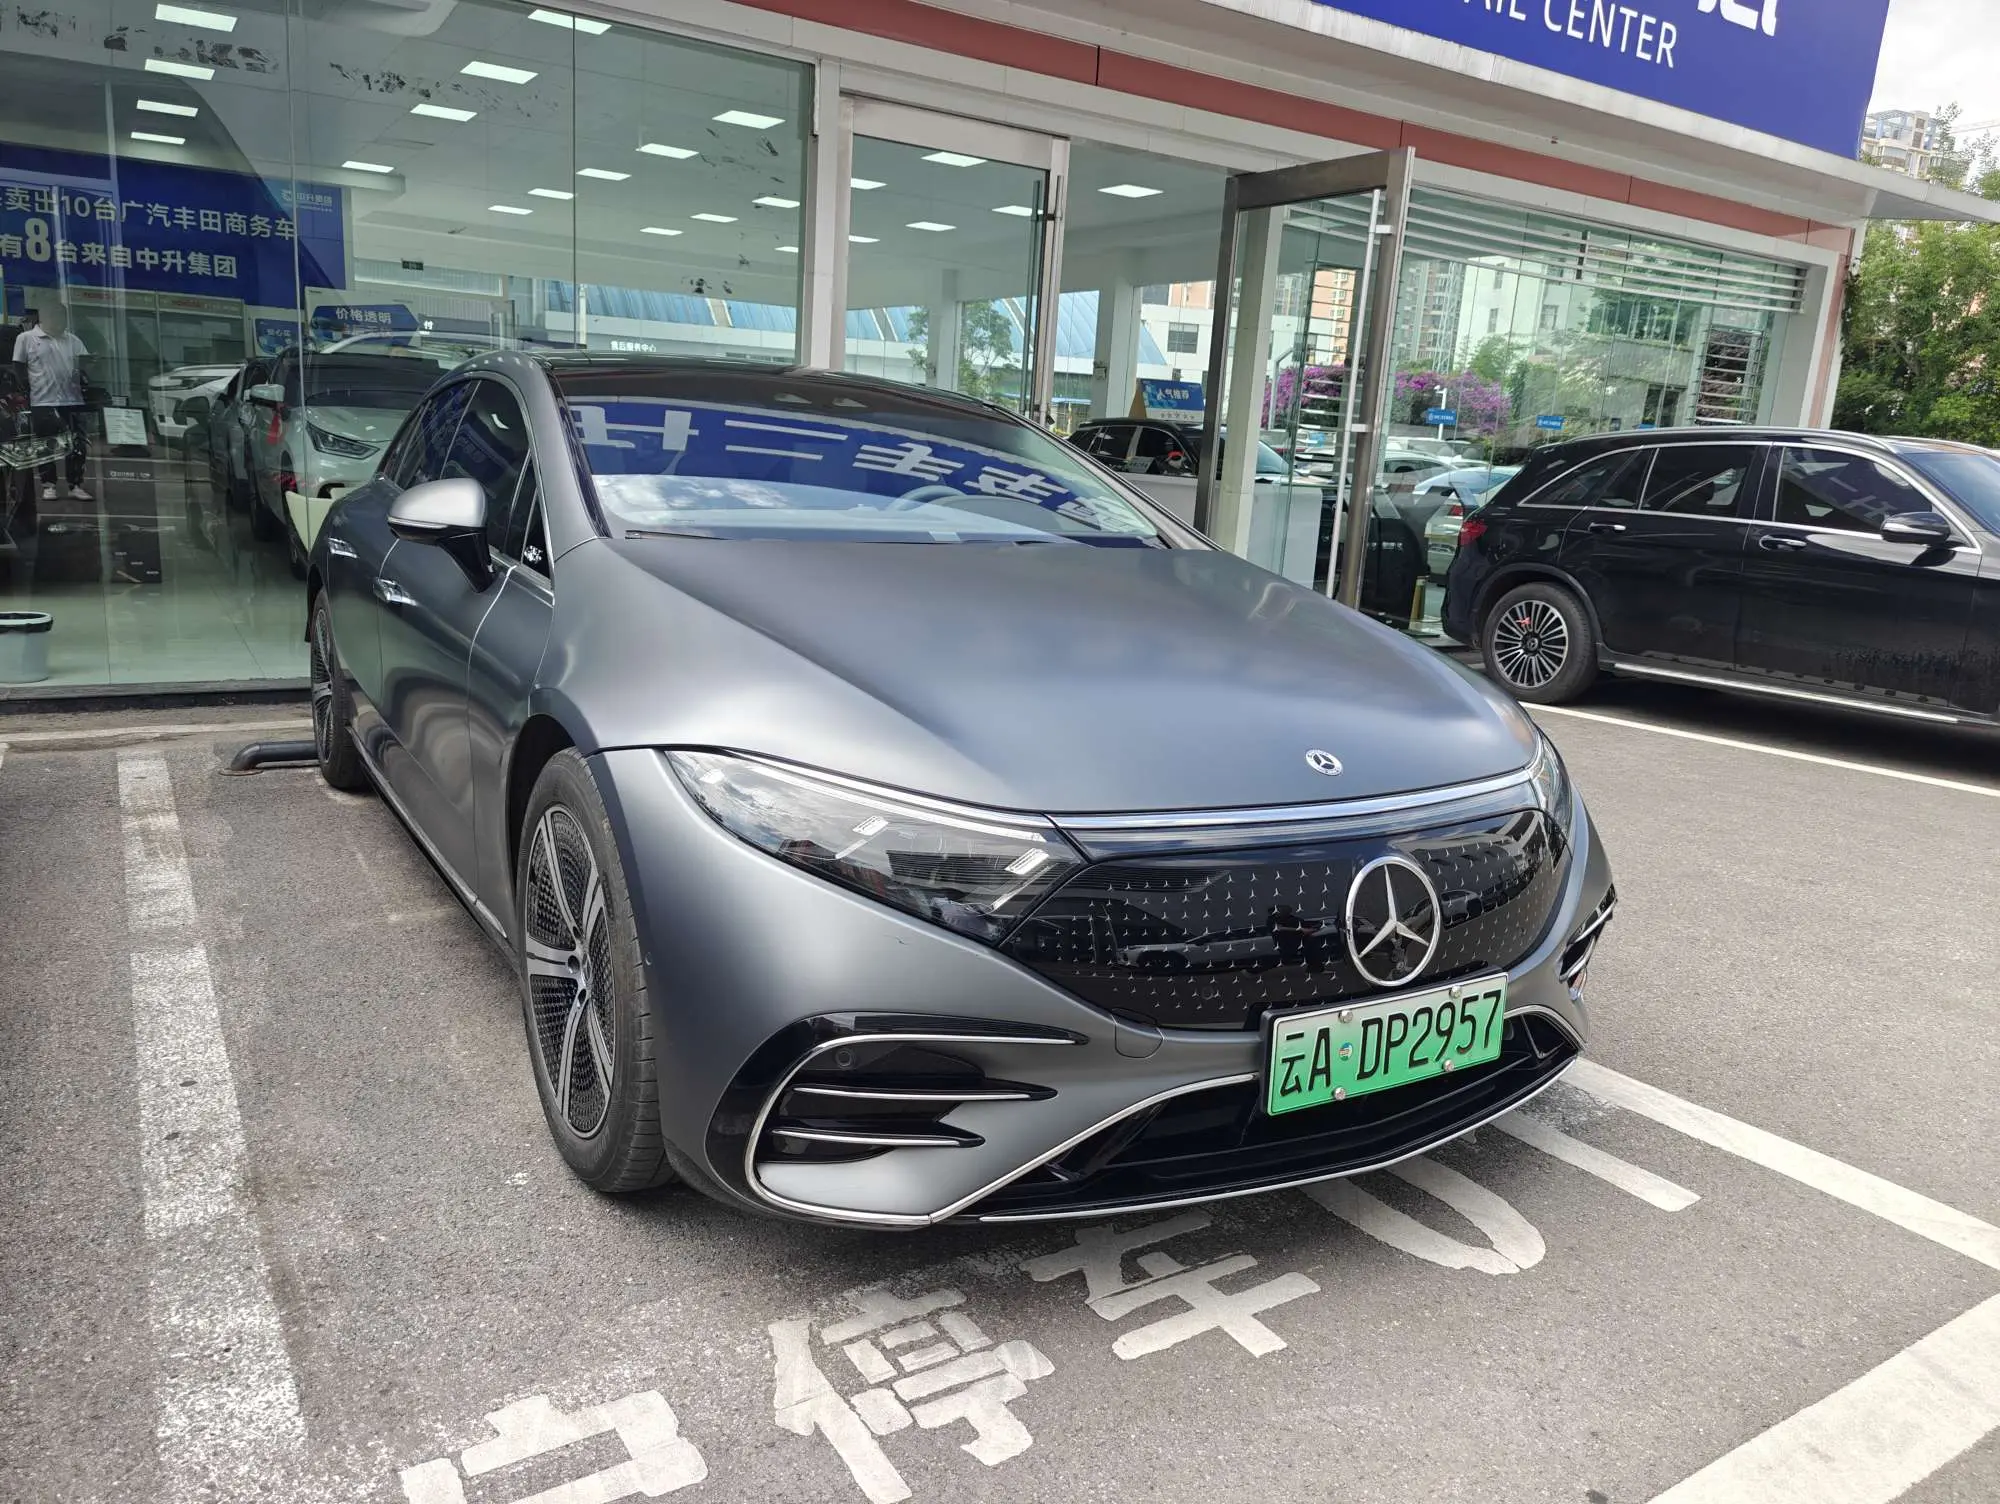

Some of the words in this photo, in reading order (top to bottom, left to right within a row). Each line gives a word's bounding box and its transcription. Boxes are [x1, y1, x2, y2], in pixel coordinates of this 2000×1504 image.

[1543, 0, 1675, 68] CENTER
[0, 184, 296, 240] 卖出10台广汽丰田商务车
